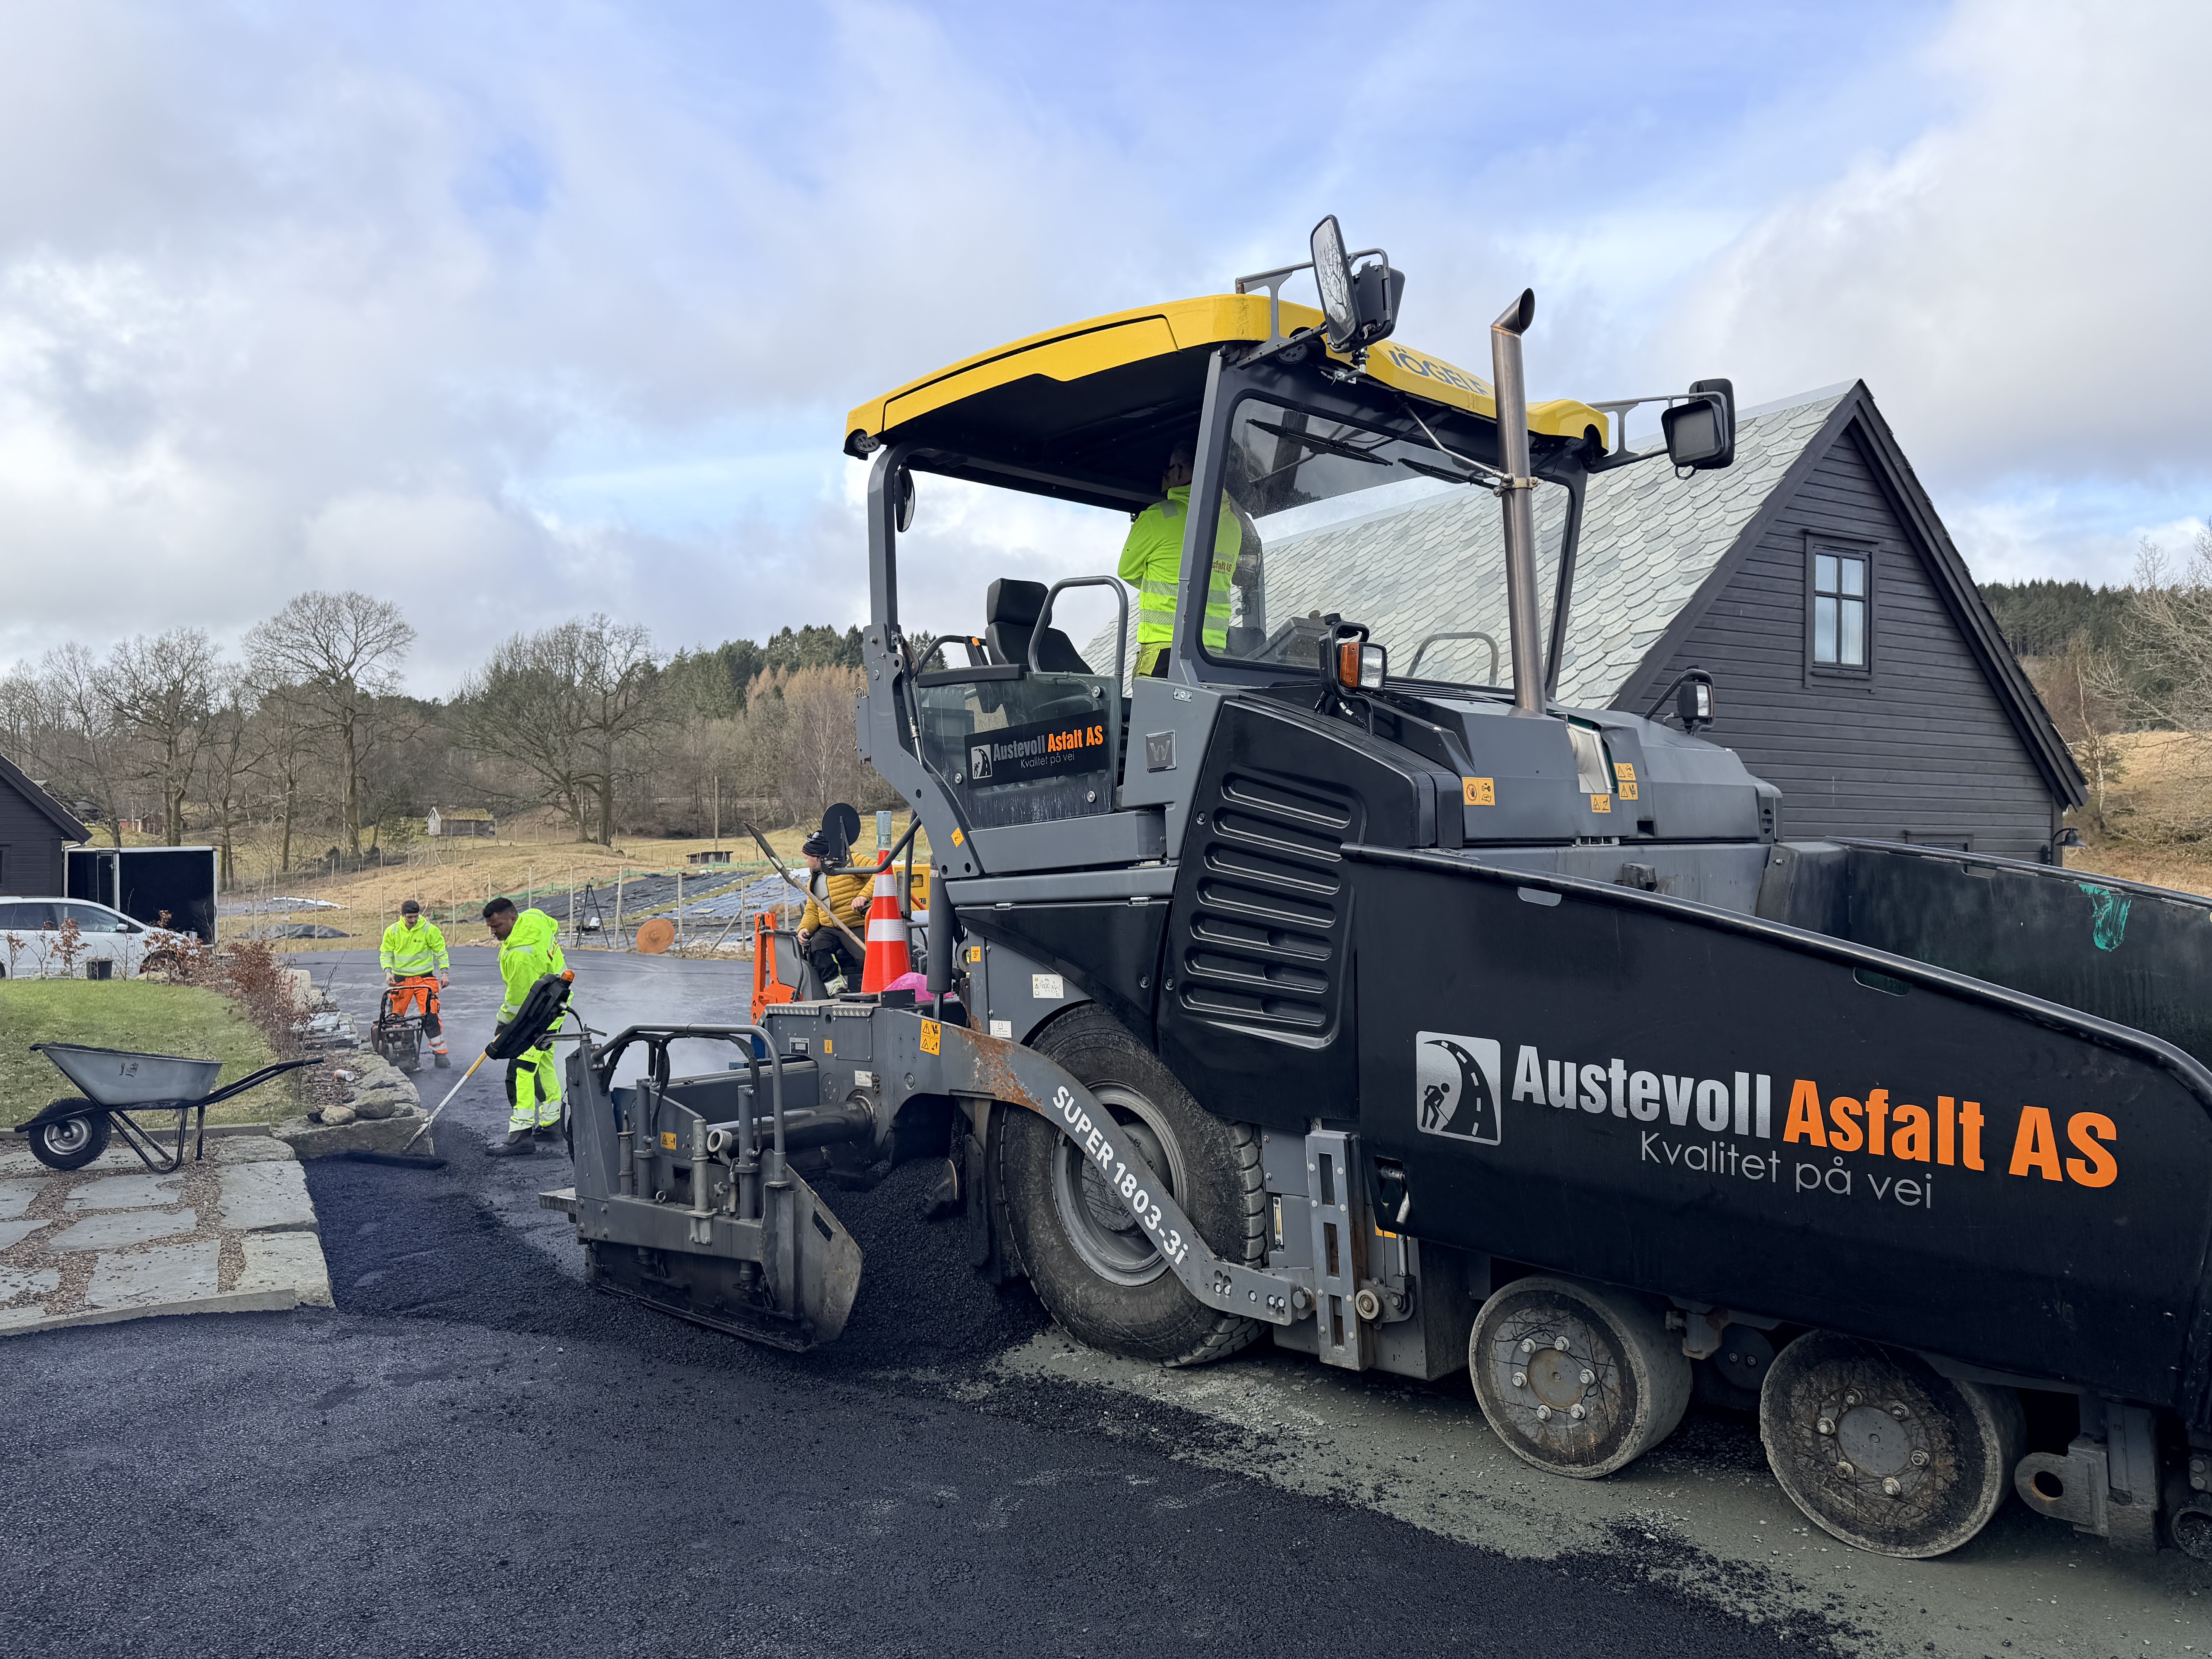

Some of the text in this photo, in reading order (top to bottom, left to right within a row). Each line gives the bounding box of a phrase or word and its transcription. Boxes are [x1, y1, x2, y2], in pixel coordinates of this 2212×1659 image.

[993, 725, 1104, 761] Austevoll Asfalt AS
[1020, 751, 1075, 769] Kvalitet på vei
[1511, 1044, 2118, 1188] Austevoll Asfalt AS
[1052, 1085, 1189, 1265] SUPER 1803-3i
[1641, 1130, 1932, 1209] Kvalitet på vei
